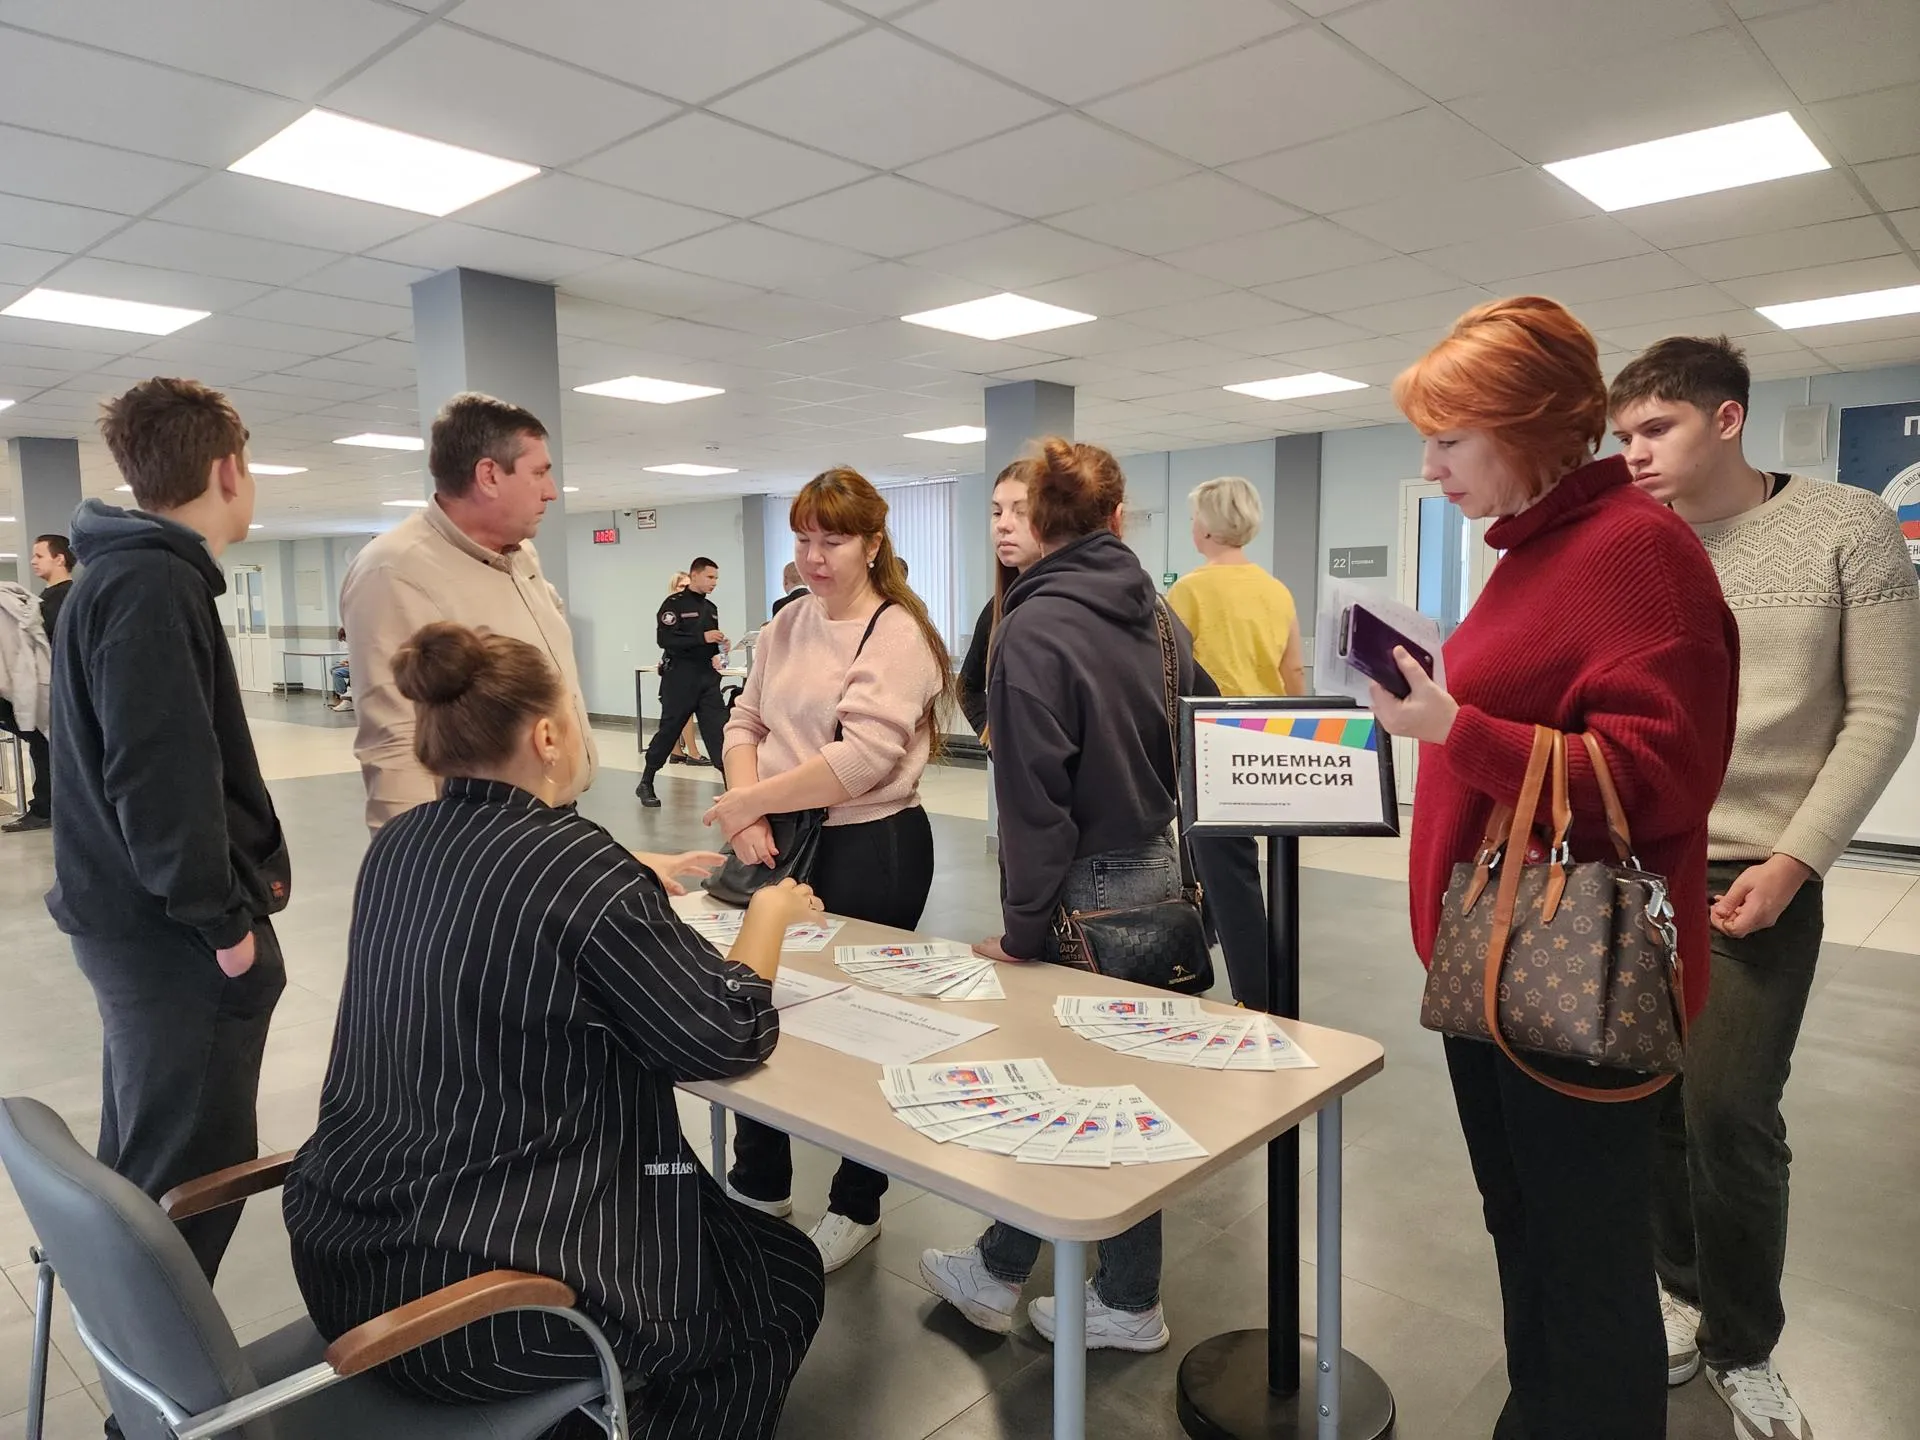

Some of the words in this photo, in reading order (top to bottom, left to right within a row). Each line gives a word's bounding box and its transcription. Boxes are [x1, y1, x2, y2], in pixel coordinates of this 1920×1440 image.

[1333, 558, 1346, 569] 22
[1231, 754, 1351, 768] ПРИЕМНАЯ
[1231, 772, 1354, 786] КОМИССИЯ
[644, 1163, 669, 1175] TIME
[671, 1162, 693, 1174] HAS
